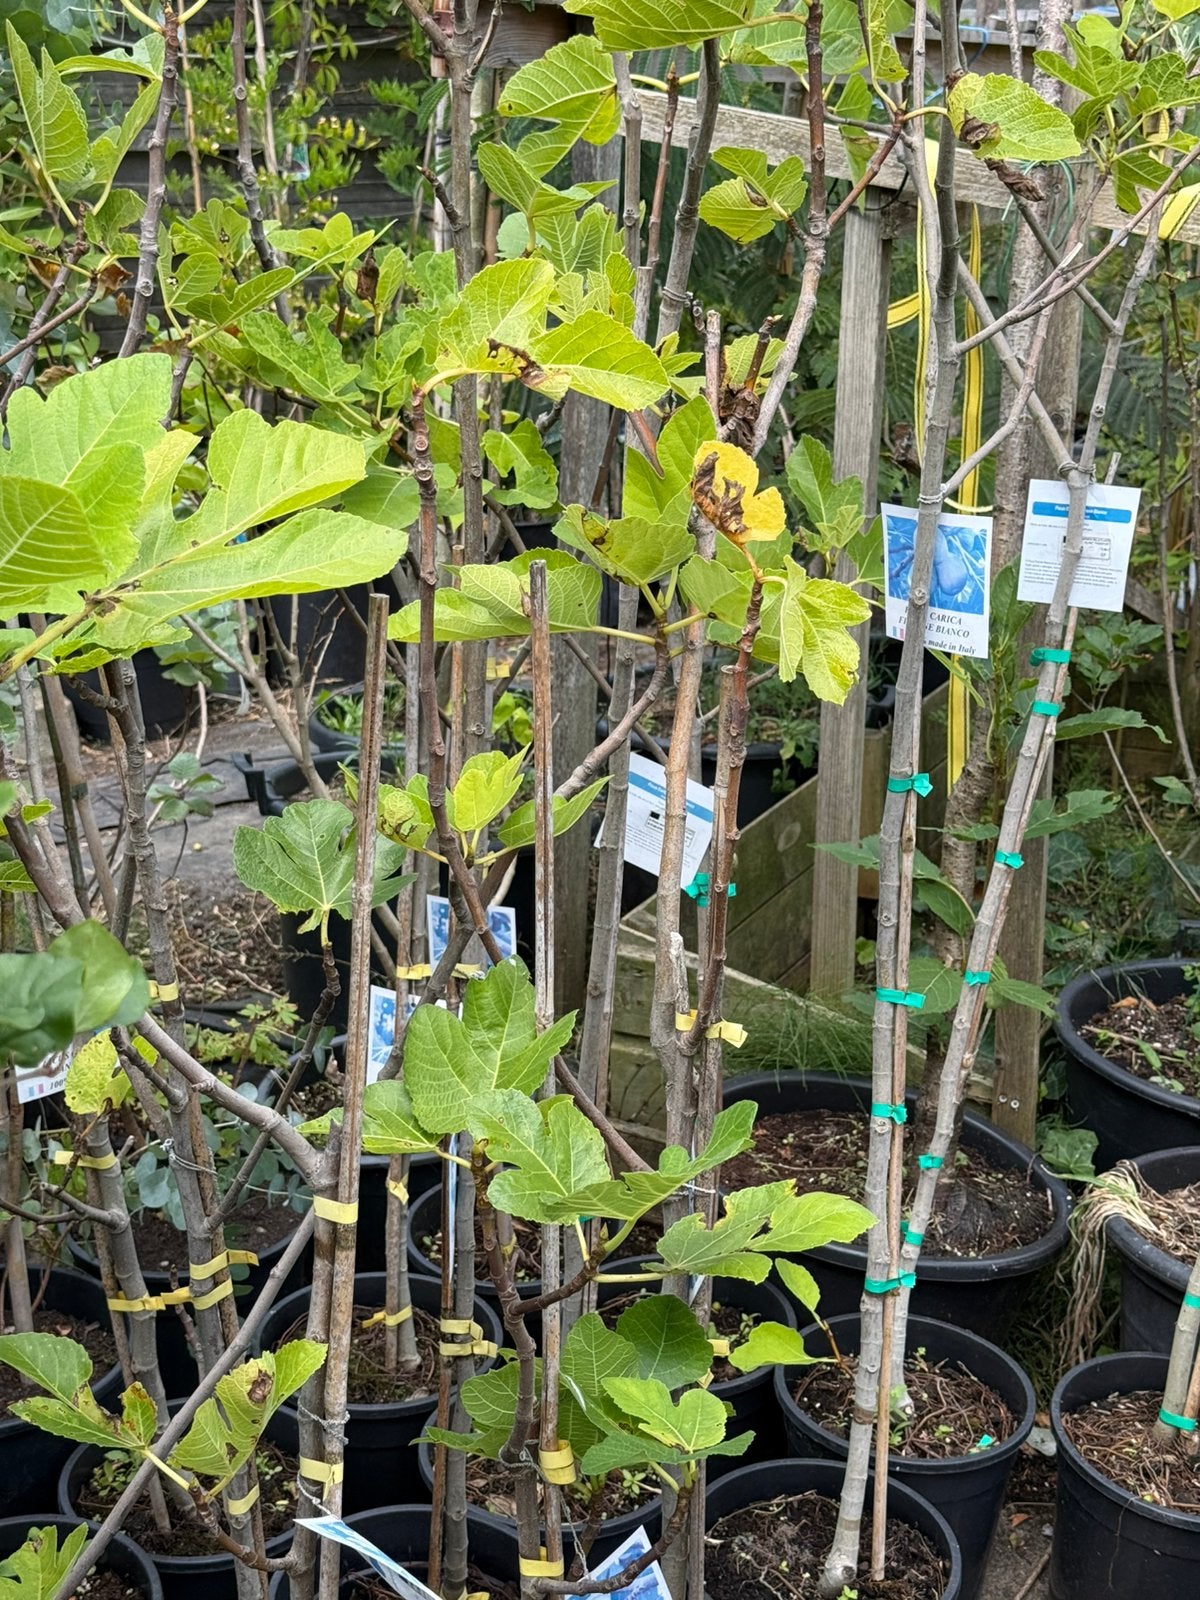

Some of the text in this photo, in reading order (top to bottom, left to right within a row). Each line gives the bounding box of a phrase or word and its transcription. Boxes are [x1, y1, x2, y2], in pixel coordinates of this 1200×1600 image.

[929, 612, 962, 626] CARICA
[935, 625, 970, 638] BIANCO
[928, 638, 947, 649] made
[948, 642, 957, 651] in
[958, 643, 976, 655] Italy
